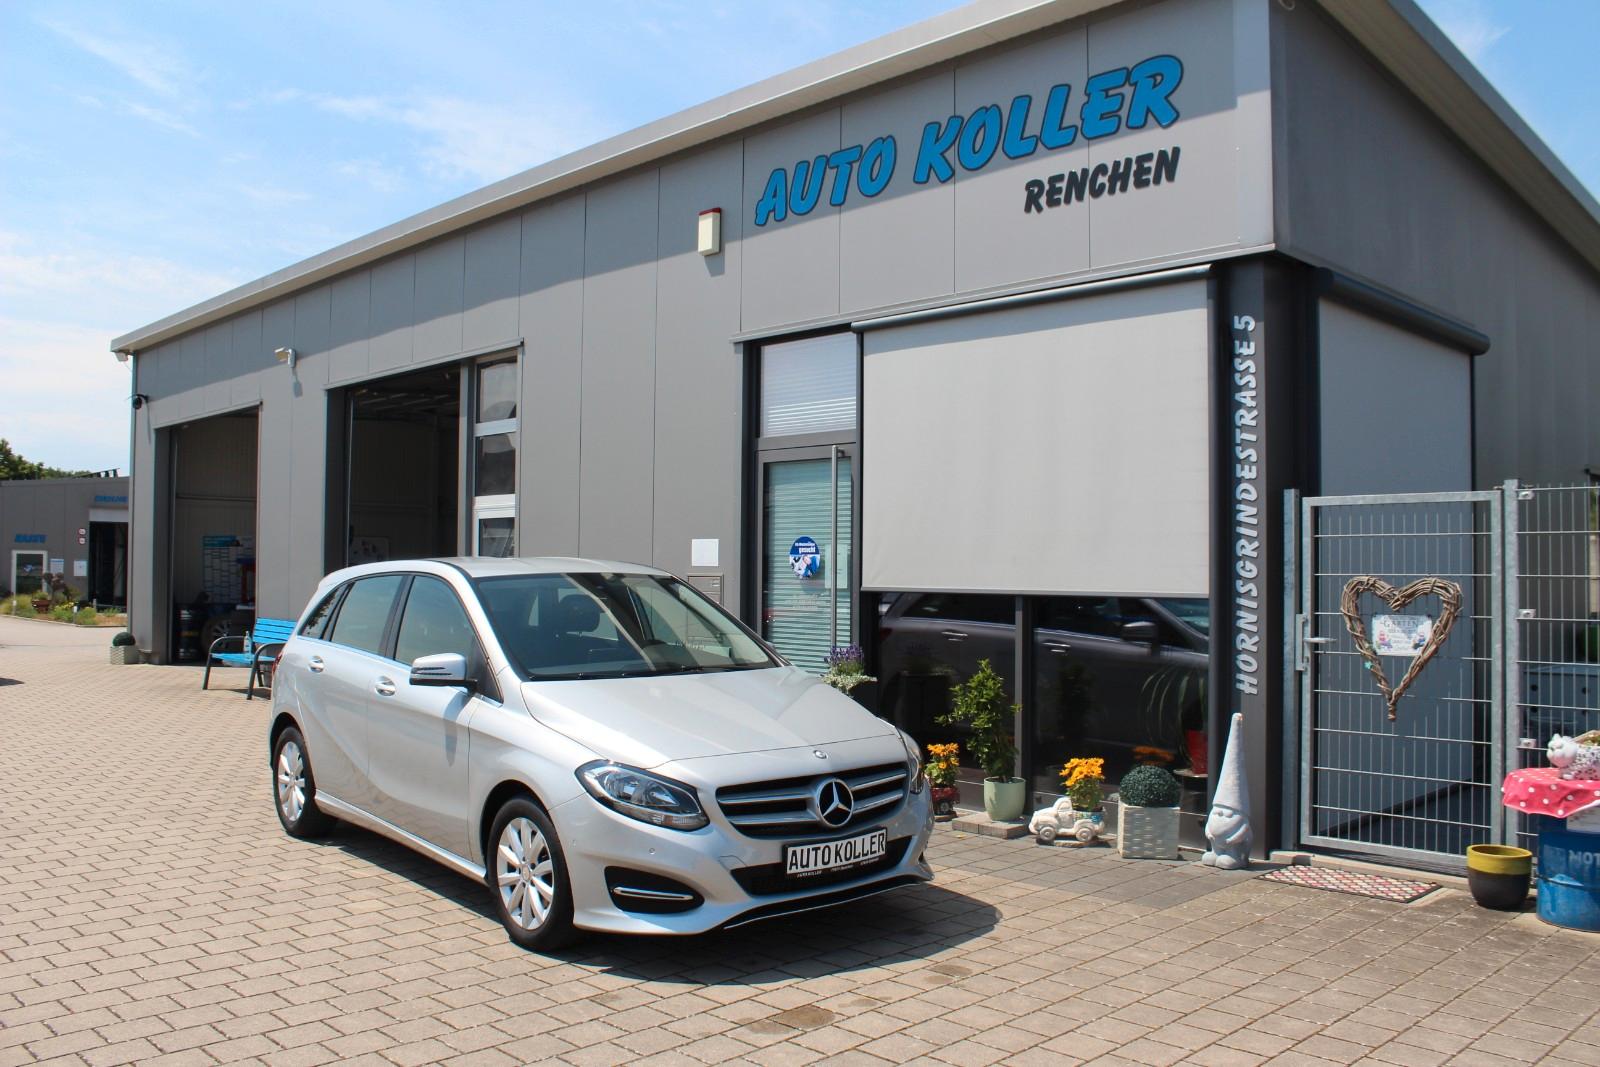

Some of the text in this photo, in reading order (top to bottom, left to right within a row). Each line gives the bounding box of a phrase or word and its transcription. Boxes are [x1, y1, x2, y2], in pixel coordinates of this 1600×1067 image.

[754, 54, 1184, 226] AUTO KOLLER
[1024, 146, 1181, 214] RENCHEN
[1234, 314, 1259, 695] HORNISGRINDESTRASSE 5
[789, 832, 886, 871] AUTO KOLLER
